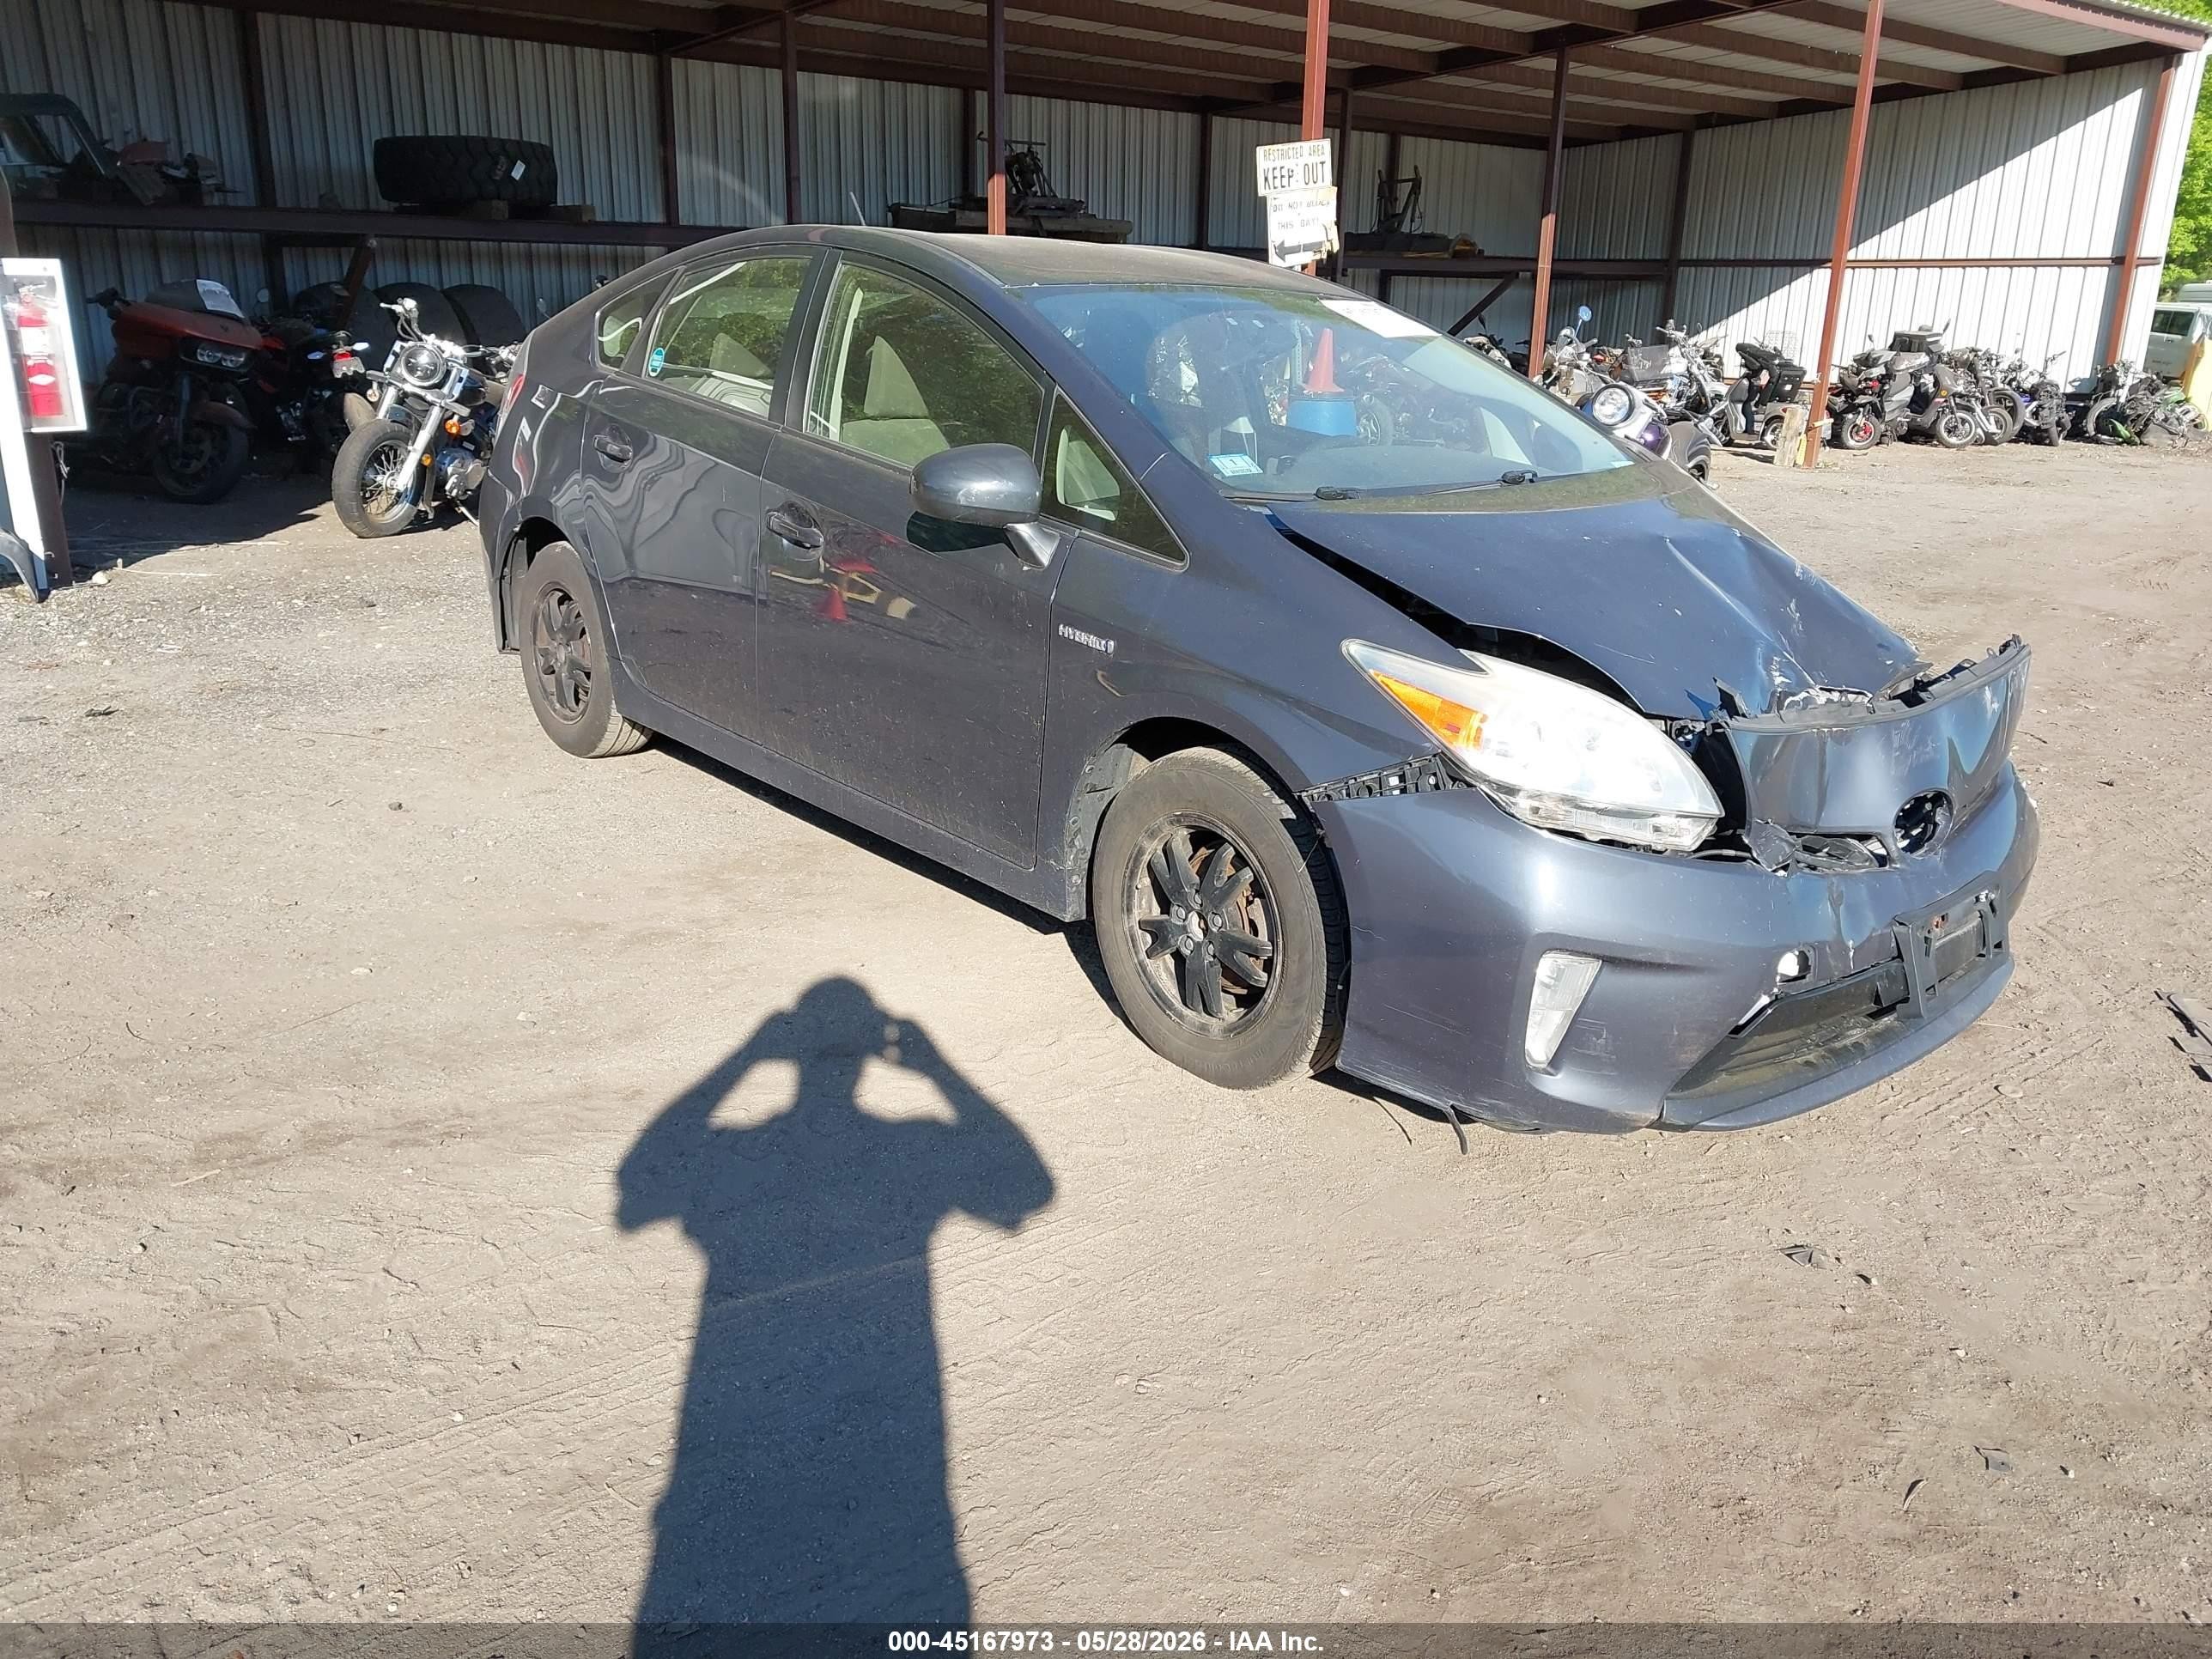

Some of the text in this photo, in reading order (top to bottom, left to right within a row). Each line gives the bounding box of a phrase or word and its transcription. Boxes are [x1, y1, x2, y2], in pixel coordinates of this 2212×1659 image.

[1263, 143, 1325, 162] RESTRICTED AREA
[1263, 161, 1326, 191] KEEP OUT
[1278, 221, 1294, 230] THIS
[1058, 623, 1107, 653] HYBRID
